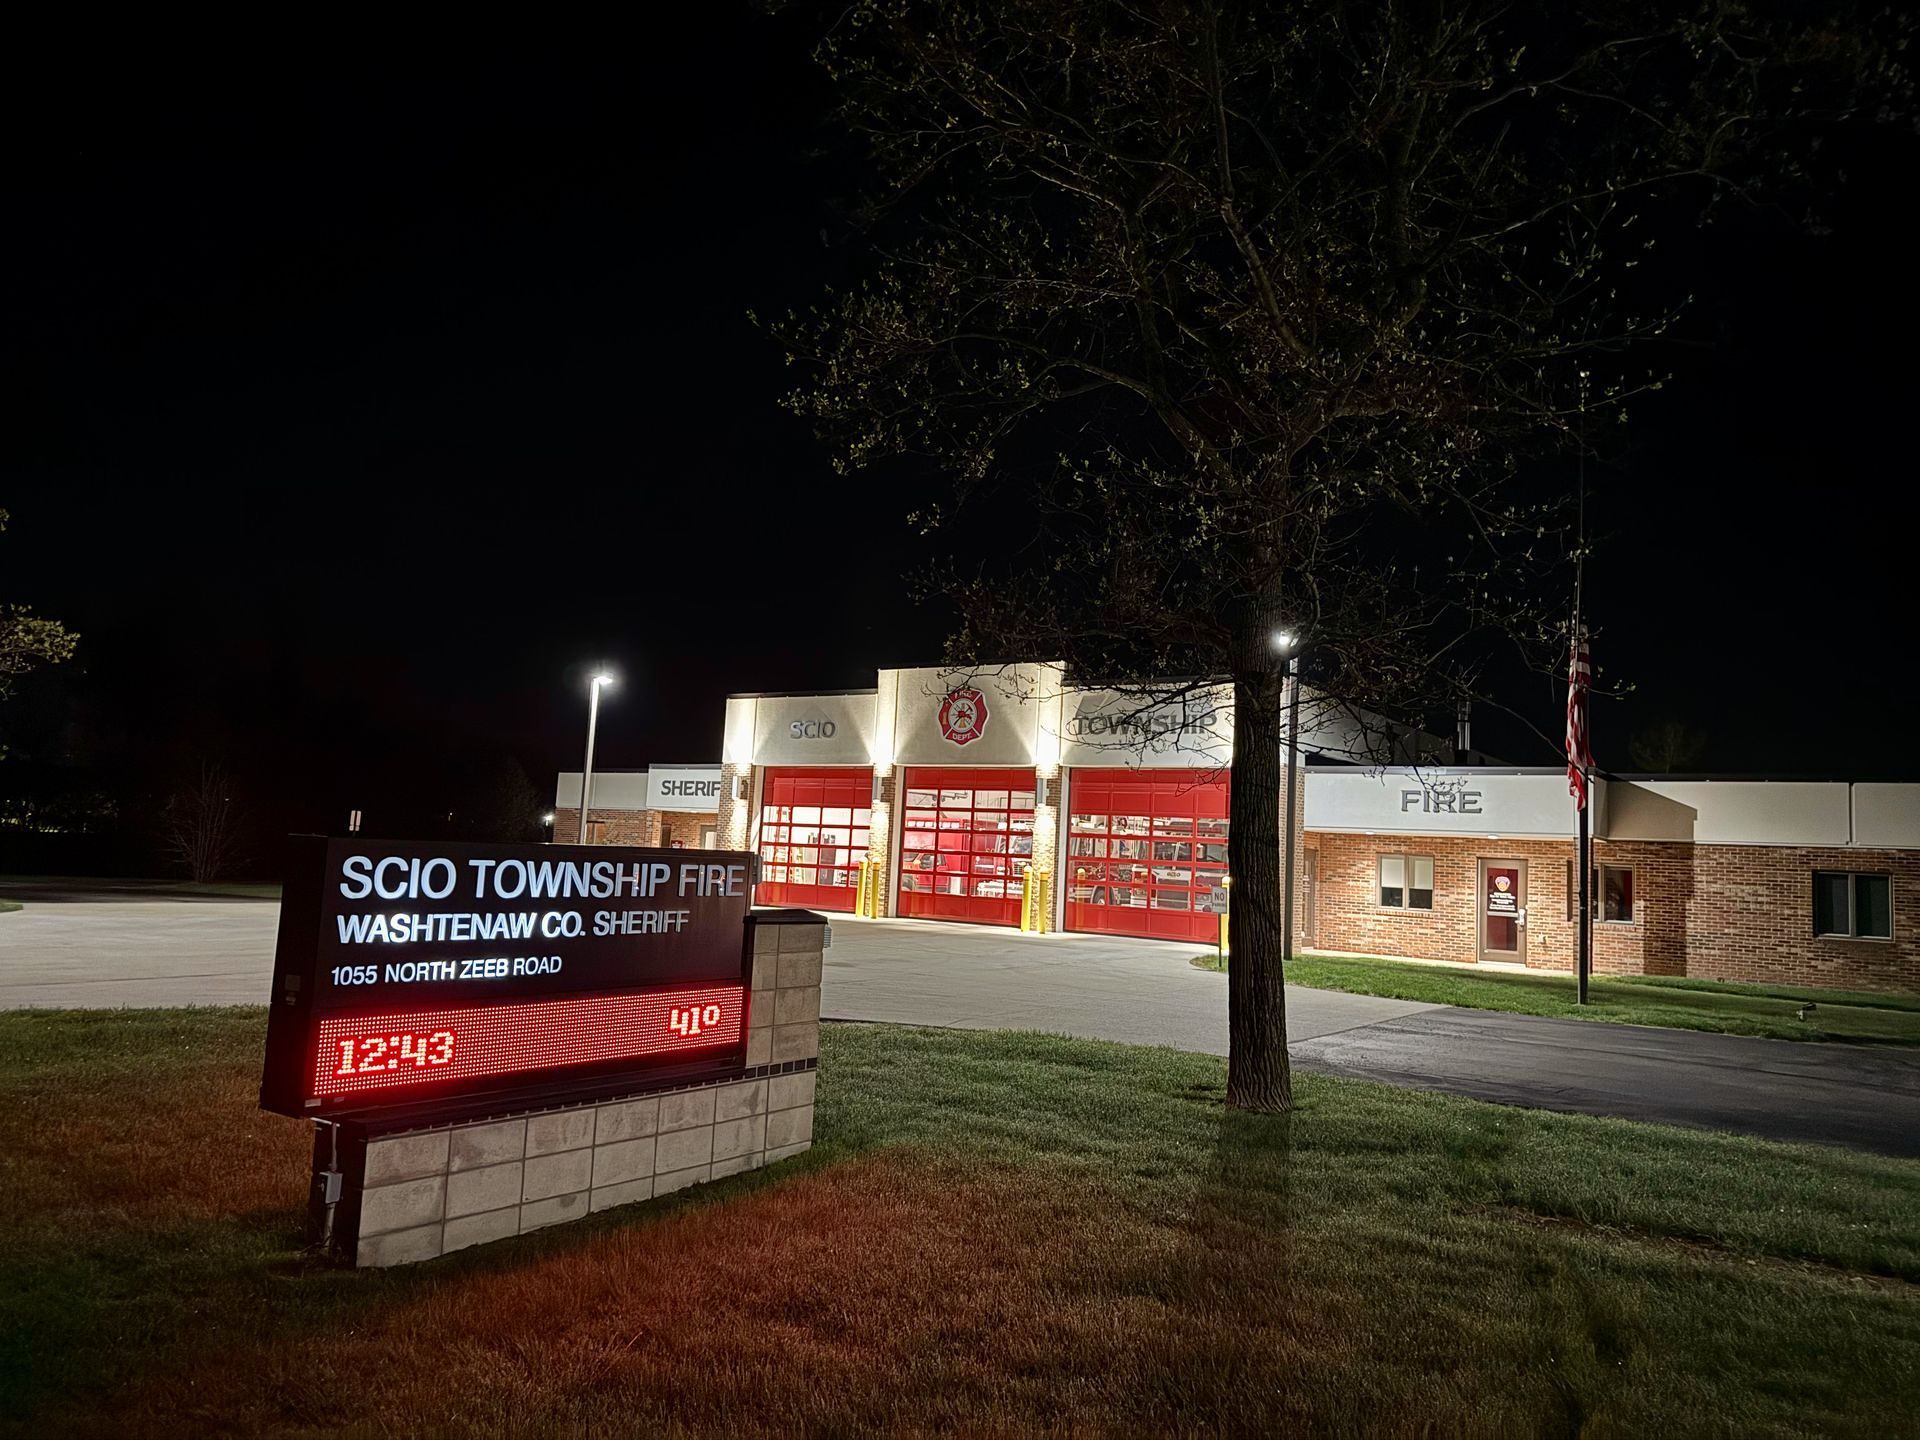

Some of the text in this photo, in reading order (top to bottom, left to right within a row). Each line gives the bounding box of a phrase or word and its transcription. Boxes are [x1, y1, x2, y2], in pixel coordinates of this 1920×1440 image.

[790, 720, 836, 739] SCIO
[1401, 790, 1483, 813] FIRE
[340, 856, 744, 900] SCIO TOWNSHIP FIRE
[1214, 892, 1225, 901] NO
[337, 909, 689, 943] WASHTENAW CO. SHERIFF
[331, 956, 562, 986] 1055 NORTH ZEEB ROAD
[337, 1031, 454, 1075] 12:43
